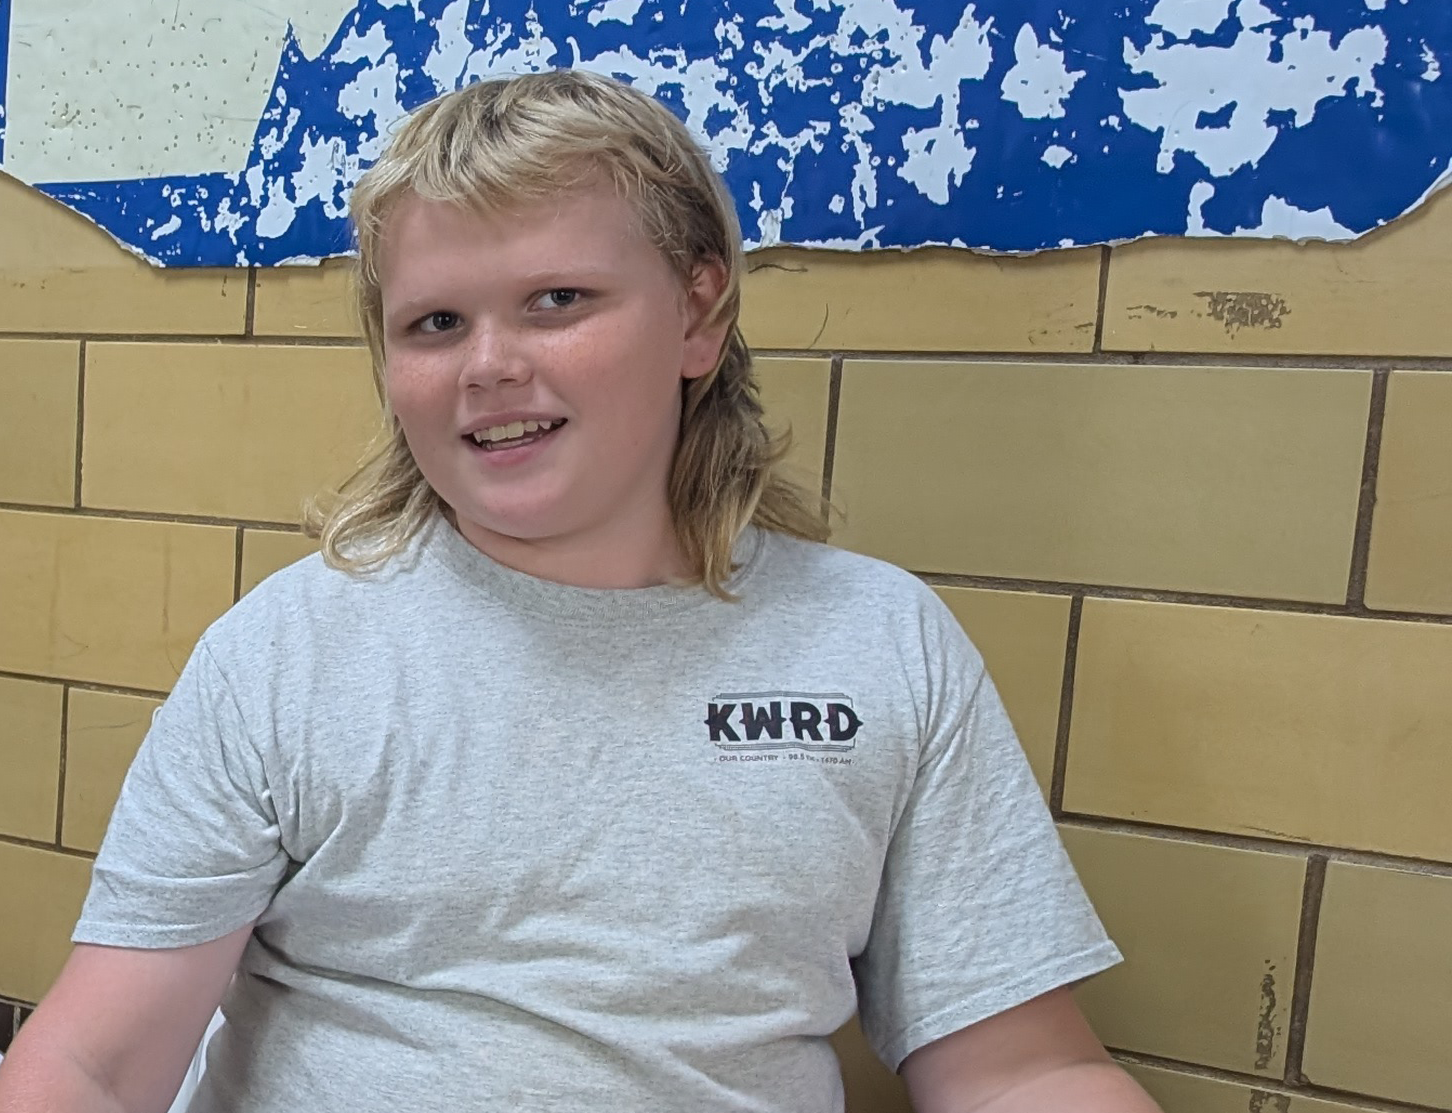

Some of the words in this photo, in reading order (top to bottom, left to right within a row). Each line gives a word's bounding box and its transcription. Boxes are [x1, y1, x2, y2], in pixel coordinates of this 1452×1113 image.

[704, 701, 864, 741] KWRD
[740, 754, 778, 762] COUNTRY
[788, 753, 805, 761] 98.5
